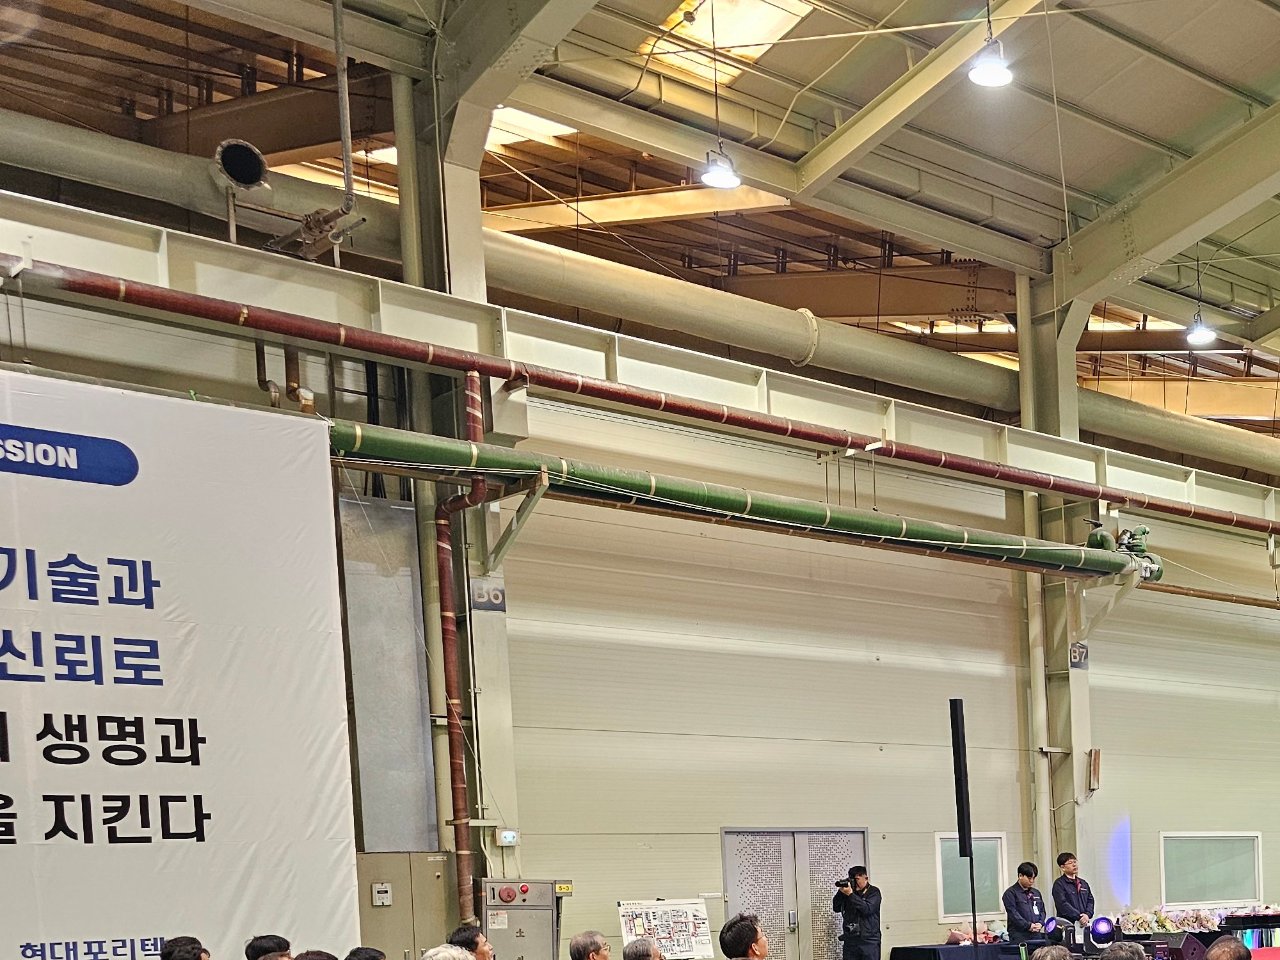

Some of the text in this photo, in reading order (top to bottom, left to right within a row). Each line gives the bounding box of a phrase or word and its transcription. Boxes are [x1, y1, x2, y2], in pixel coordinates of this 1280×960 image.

[0, 440, 78, 470] SION
[0, 630, 164, 687] 신뢰로
[1071, 648, 1087, 662] B7
[36, 713, 207, 766] 생명과
[42, 794, 212, 844] 지킨다
